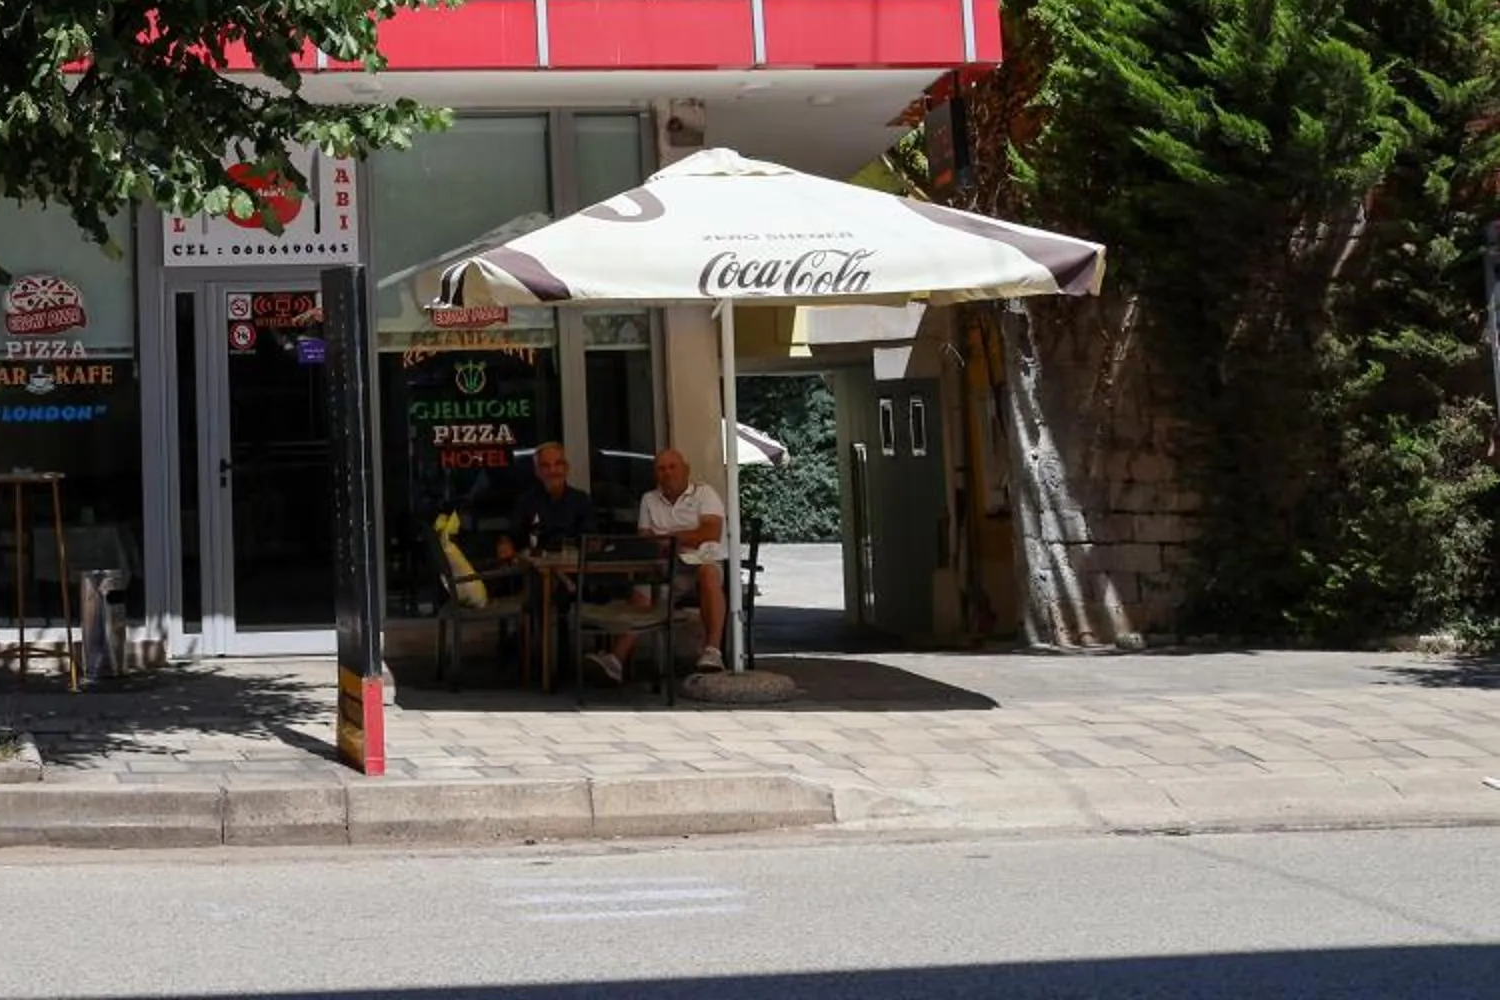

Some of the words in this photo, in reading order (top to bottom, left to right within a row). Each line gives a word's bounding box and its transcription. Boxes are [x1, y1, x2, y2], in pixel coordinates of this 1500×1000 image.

[702, 232, 759, 242] ZERO
[698, 248, 877, 297] Coca-Cola
[4, 340, 89, 360] PIZZA
[55, 365, 114, 386] KAFE
[410, 399, 532, 419] GJELLTORE
[432, 424, 517, 445] PIZZA
[441, 450, 509, 469] HOTEL
